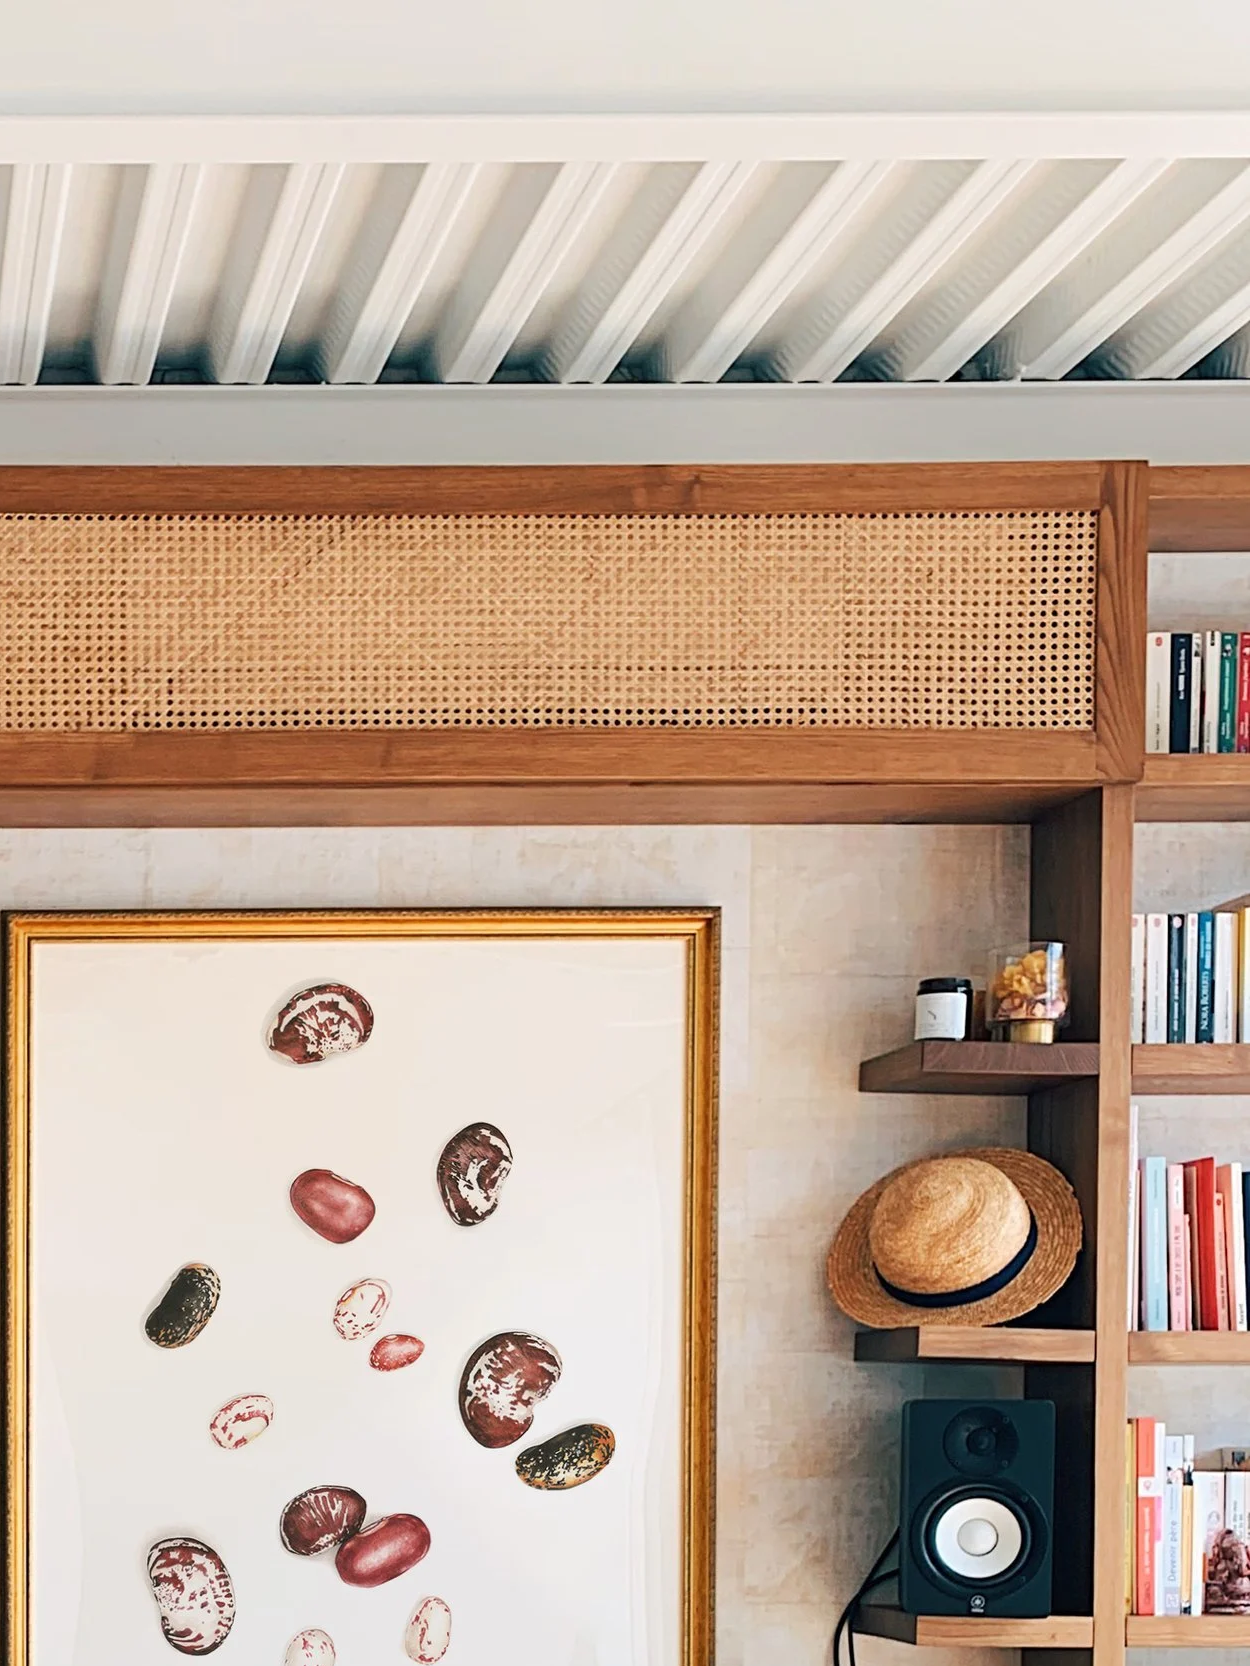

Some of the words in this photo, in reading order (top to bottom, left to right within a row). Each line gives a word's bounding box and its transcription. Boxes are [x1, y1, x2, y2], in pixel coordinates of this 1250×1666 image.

[1200, 971, 1209, 1005] ROBERTS
[1201, 1006, 1209, 1030] NORA
[1167, 1520, 1179, 1542] père
[1168, 1545, 1176, 1581] Devenir
